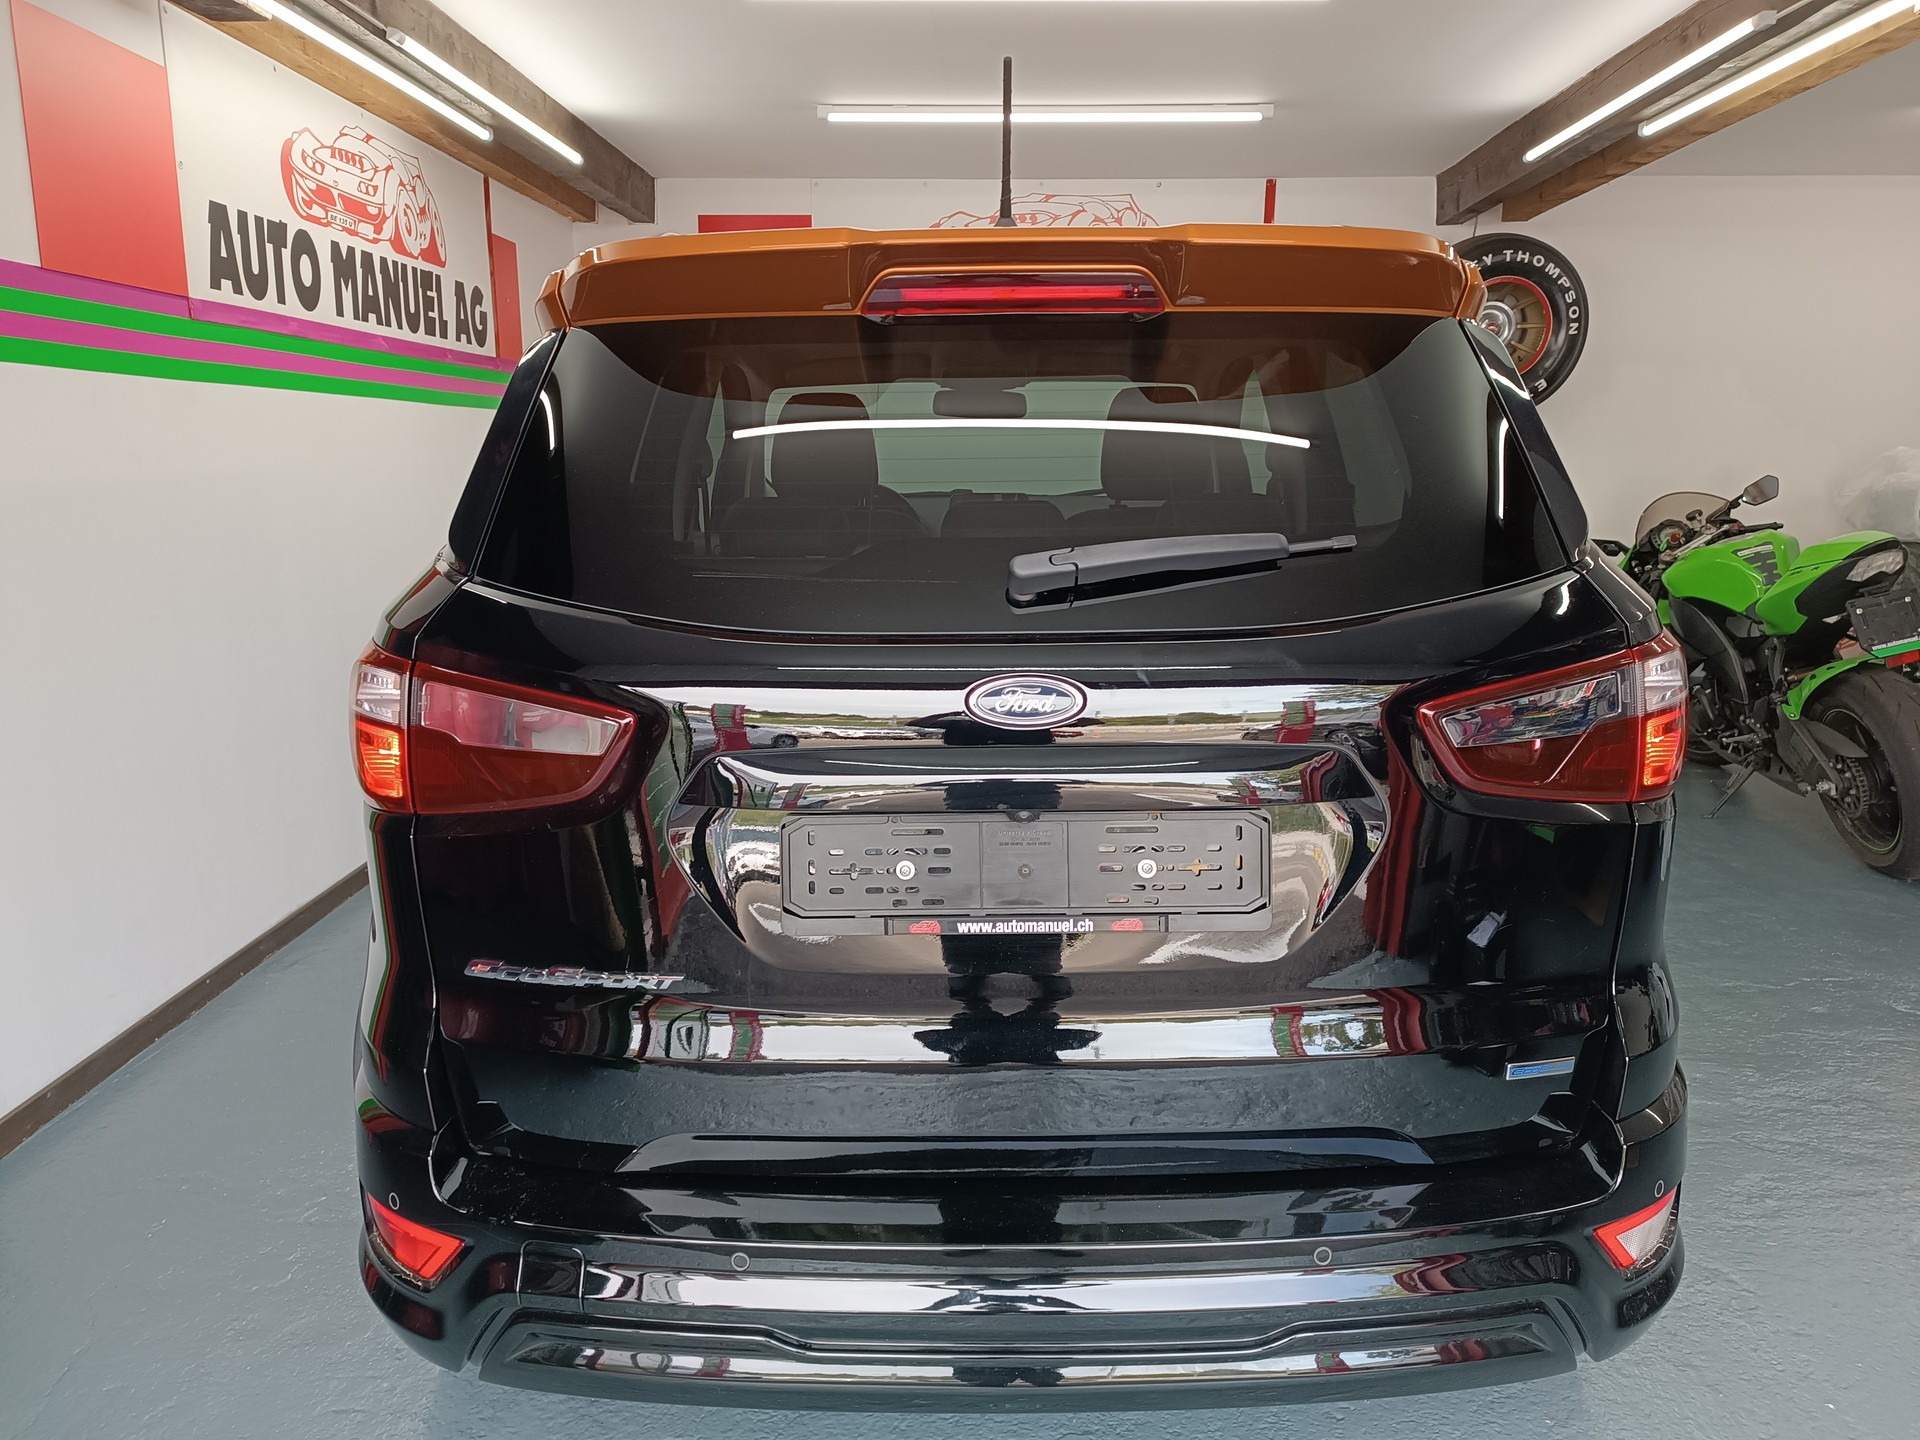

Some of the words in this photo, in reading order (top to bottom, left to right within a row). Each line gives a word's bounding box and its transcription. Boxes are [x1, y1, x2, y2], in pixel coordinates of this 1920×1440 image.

[330, 214, 338, 222] BE
[339, 217, 348, 226] 135
[208, 199, 321, 312] AUTO
[331, 239, 448, 340] MANUEL
[454, 280, 488, 348] AG
[1502, 249, 1580, 335] THOMPSON
[994, 687, 1057, 714] Ford
[956, 918, 1094, 934] www.automanuel.ch
